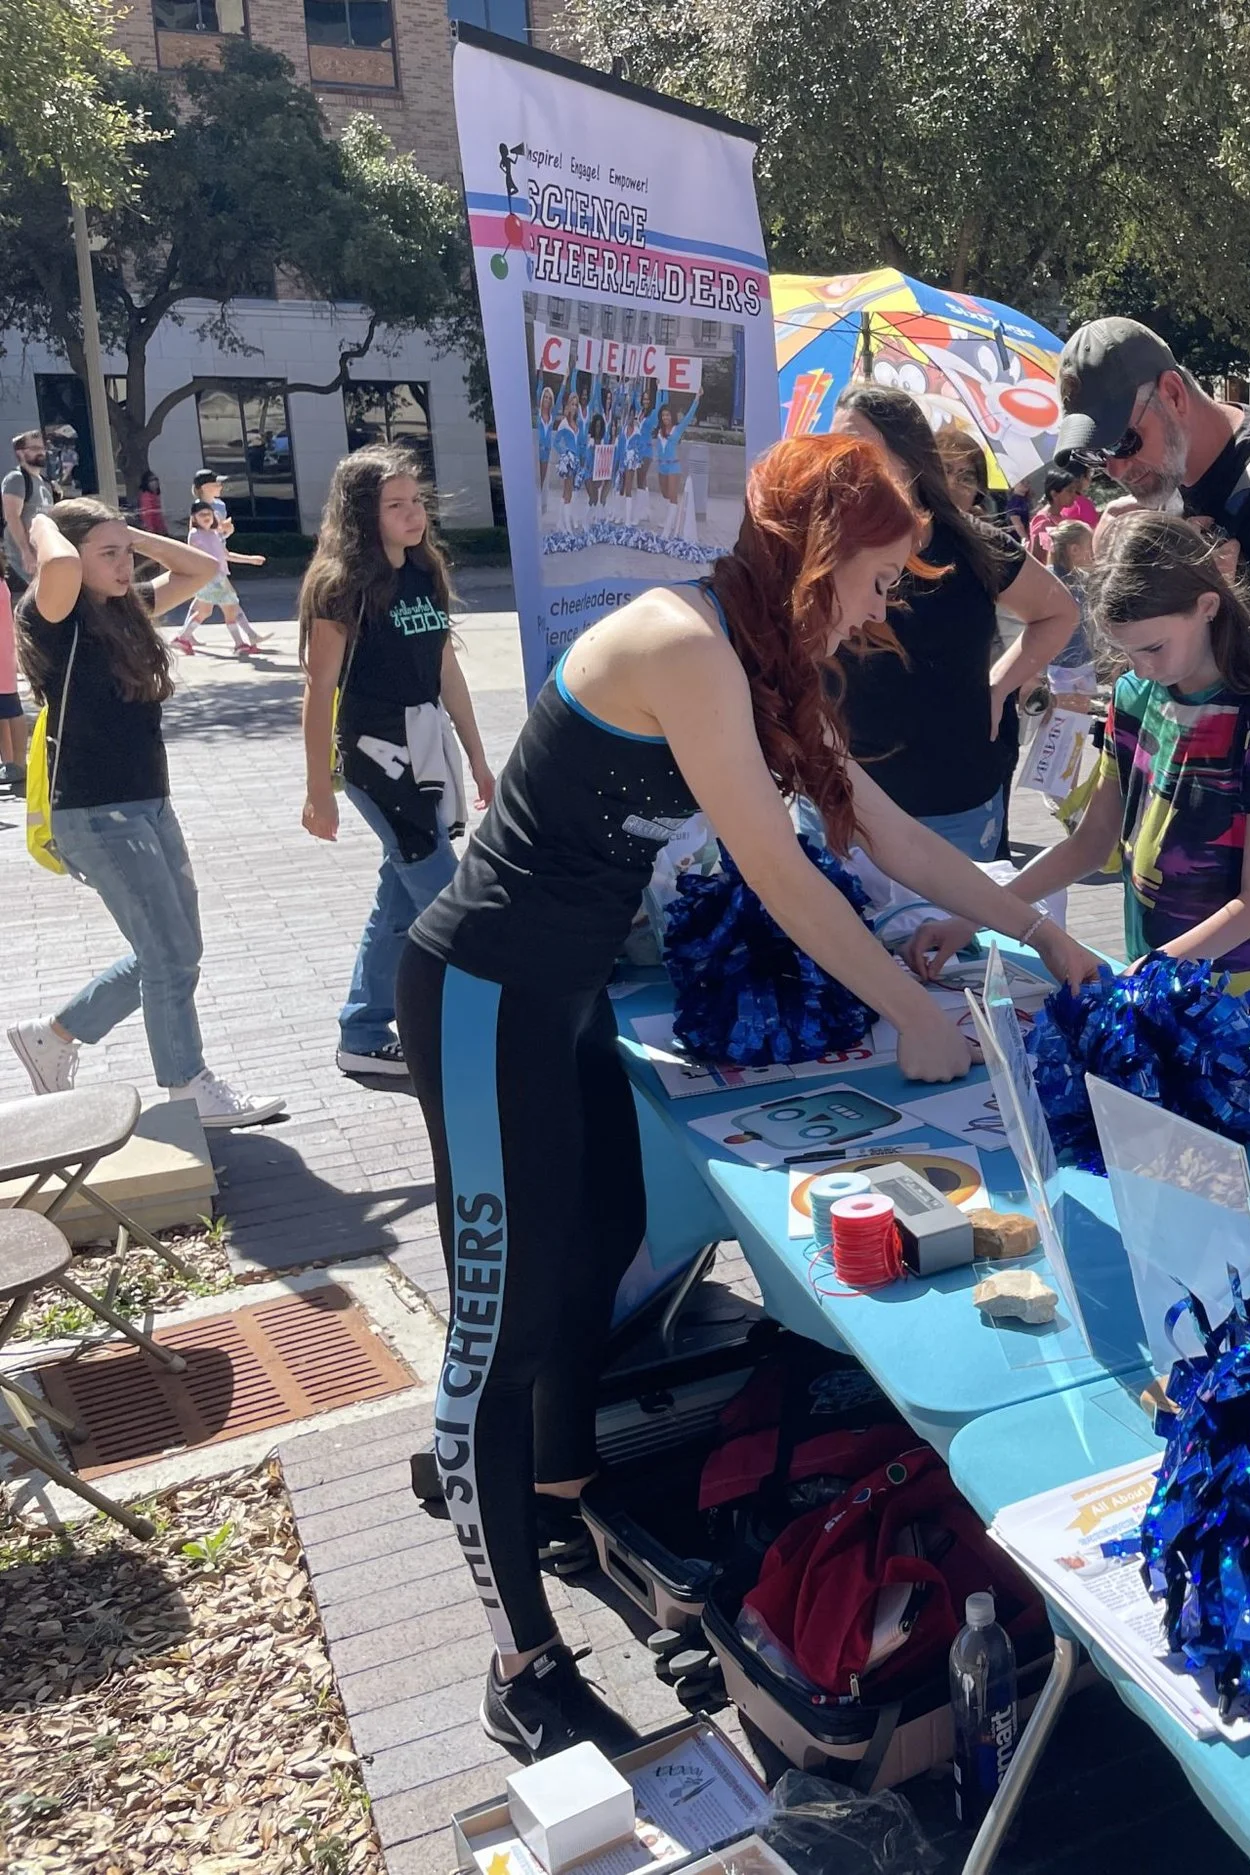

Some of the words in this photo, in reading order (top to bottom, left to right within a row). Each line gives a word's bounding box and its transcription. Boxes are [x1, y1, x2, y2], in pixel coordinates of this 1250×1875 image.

[524, 143, 562, 169] nspire!
[570, 157, 600, 181] Engage!
[609, 168, 648, 194] Empower!
[529, 235, 761, 316] HEERLEADERS
[550, 588, 631, 616] cheerleaders
[443, 1192, 504, 1399] CHEERS
[435, 1414, 472, 1505] SCI
[1111, 1486, 1149, 1506] About
[991, 1703, 1013, 1786] mart
